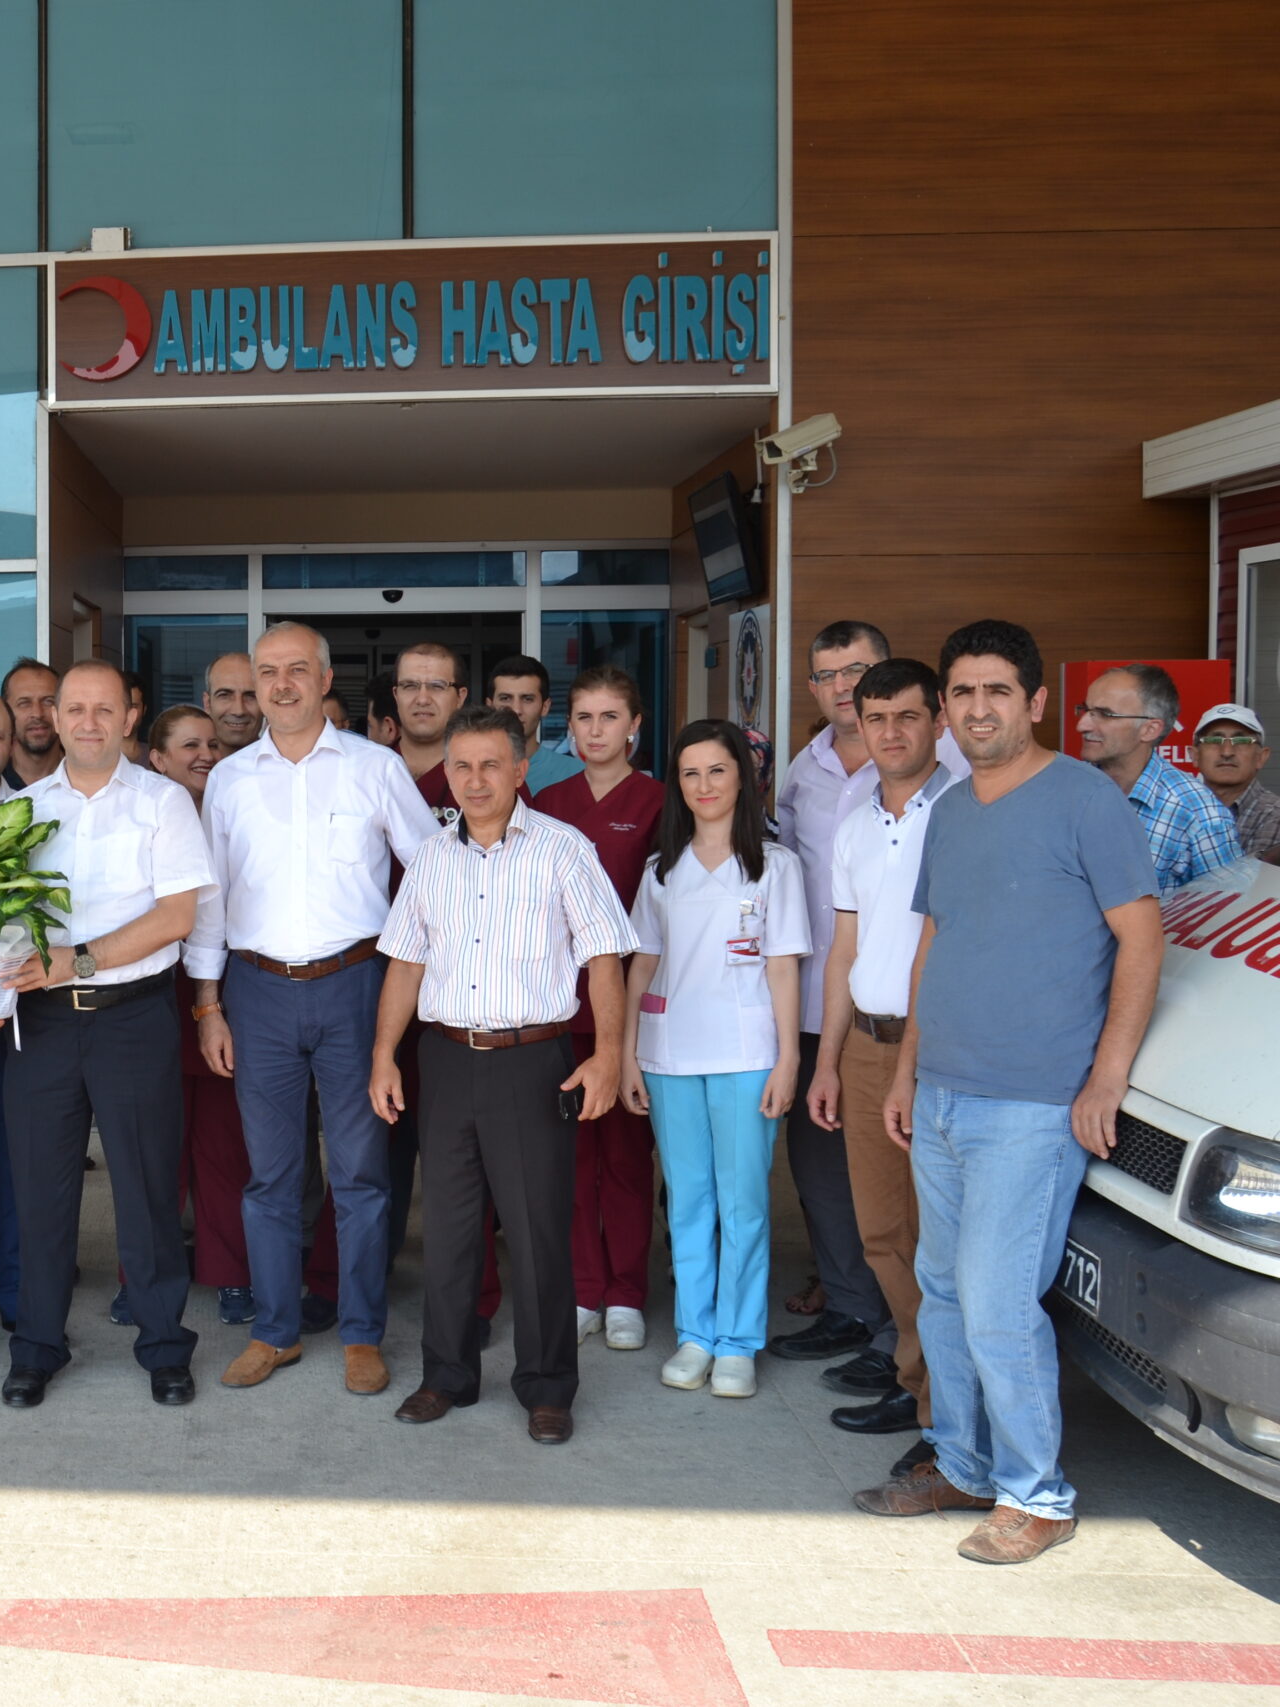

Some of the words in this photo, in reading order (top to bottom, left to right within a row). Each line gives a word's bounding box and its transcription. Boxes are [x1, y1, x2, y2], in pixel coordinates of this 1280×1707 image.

[153, 280, 419, 376] AMBULANS
[440, 277, 603, 368] HASTA
[622, 250, 770, 377] GİRİŞİ
[1064, 1247, 1098, 1307] 712
